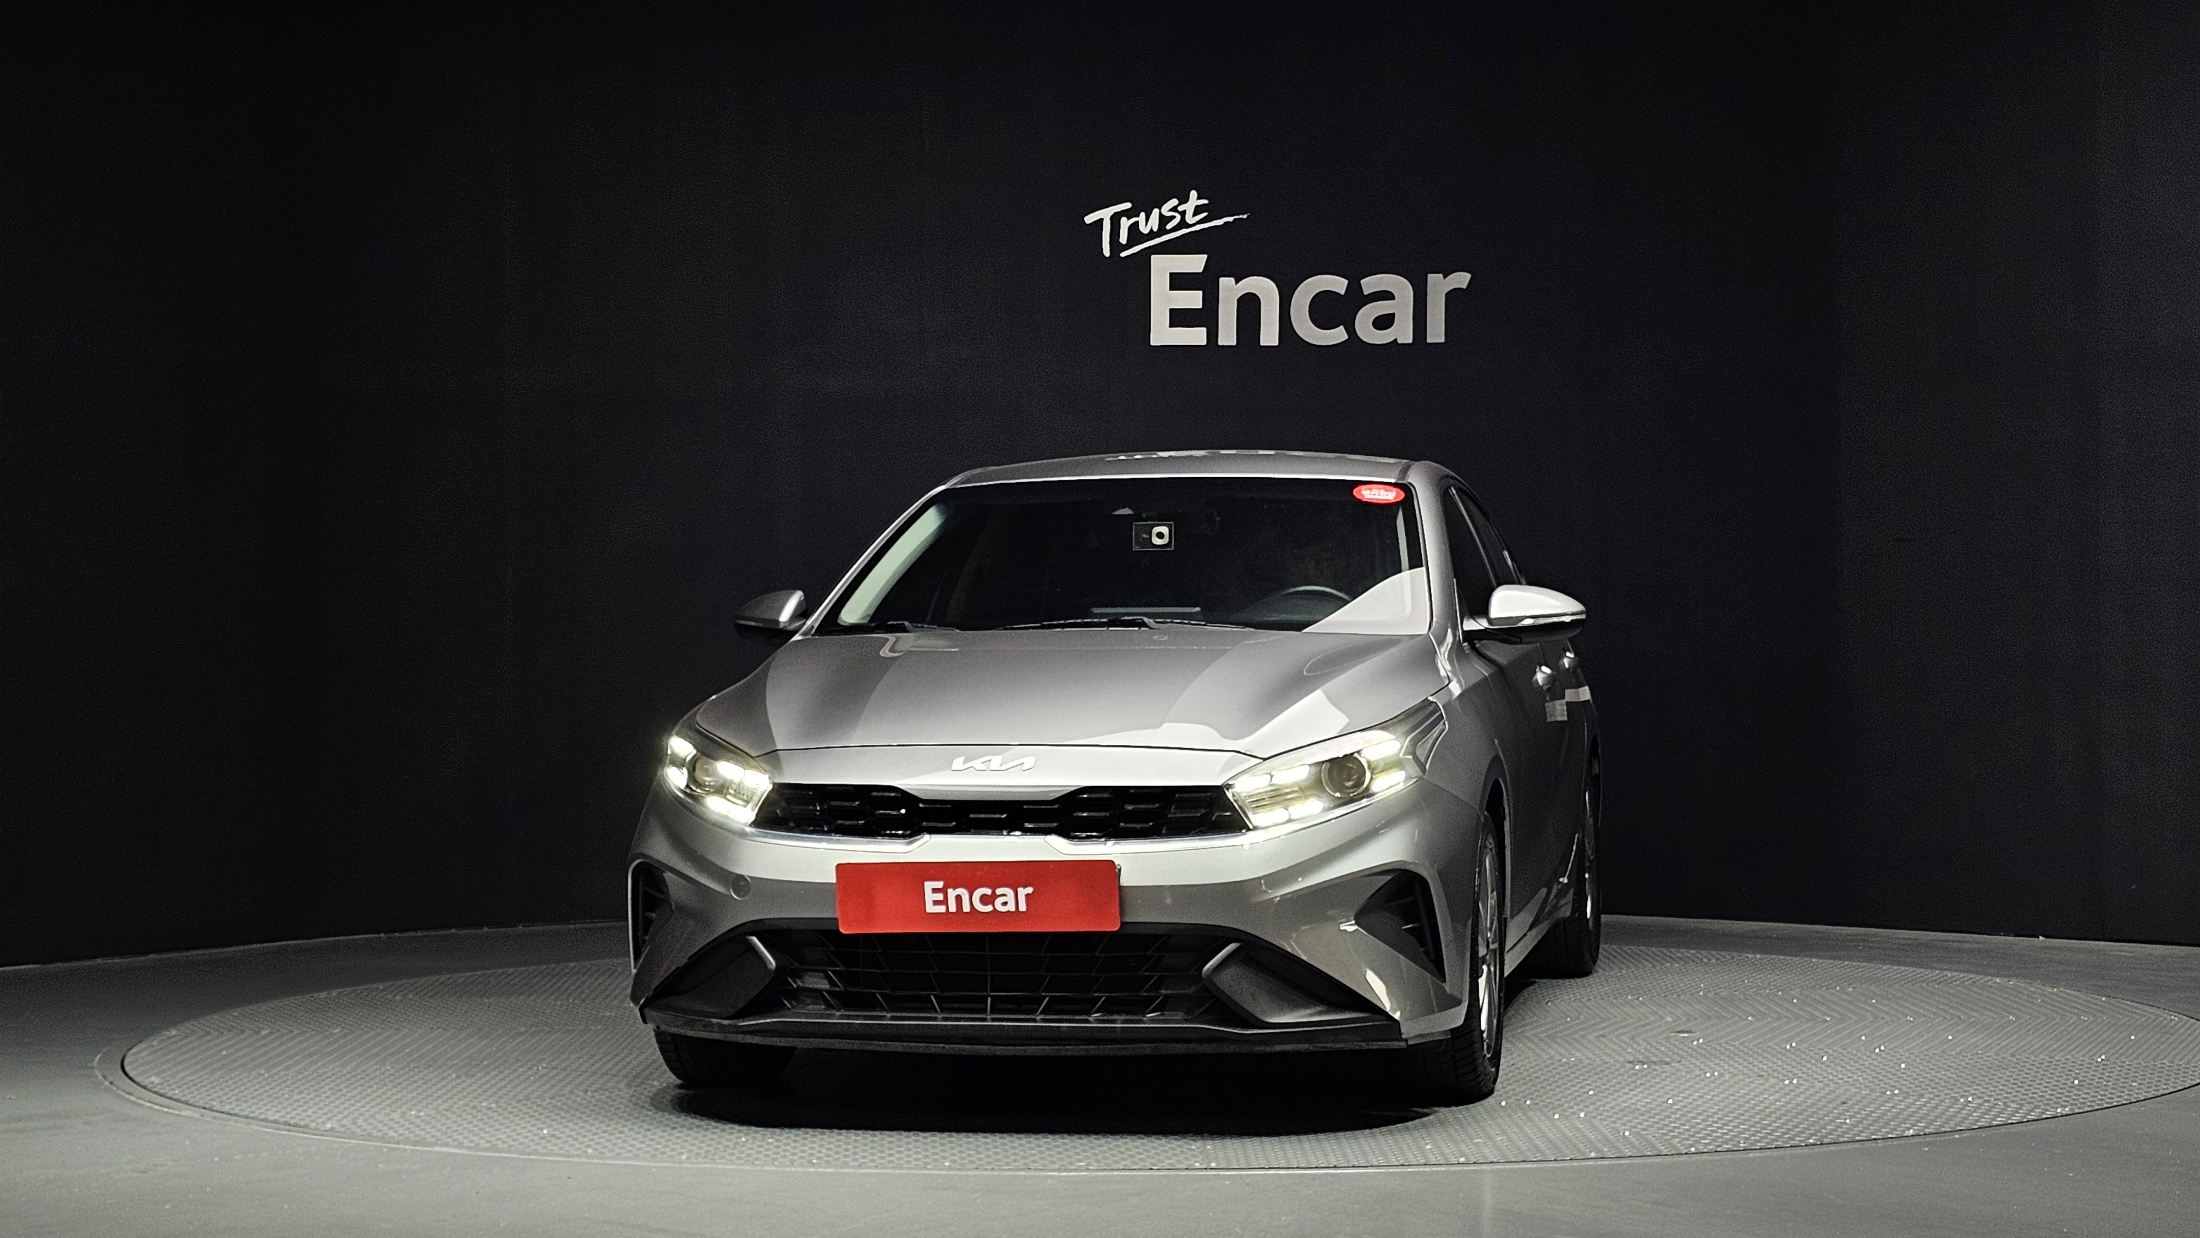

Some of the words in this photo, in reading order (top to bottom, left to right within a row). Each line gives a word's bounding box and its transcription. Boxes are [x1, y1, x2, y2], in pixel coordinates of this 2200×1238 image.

[1084, 190, 1209, 257] Trust
[1150, 254, 1472, 346] Encar
[951, 755, 1036, 771] KIA
[924, 881, 1034, 913] Encar
